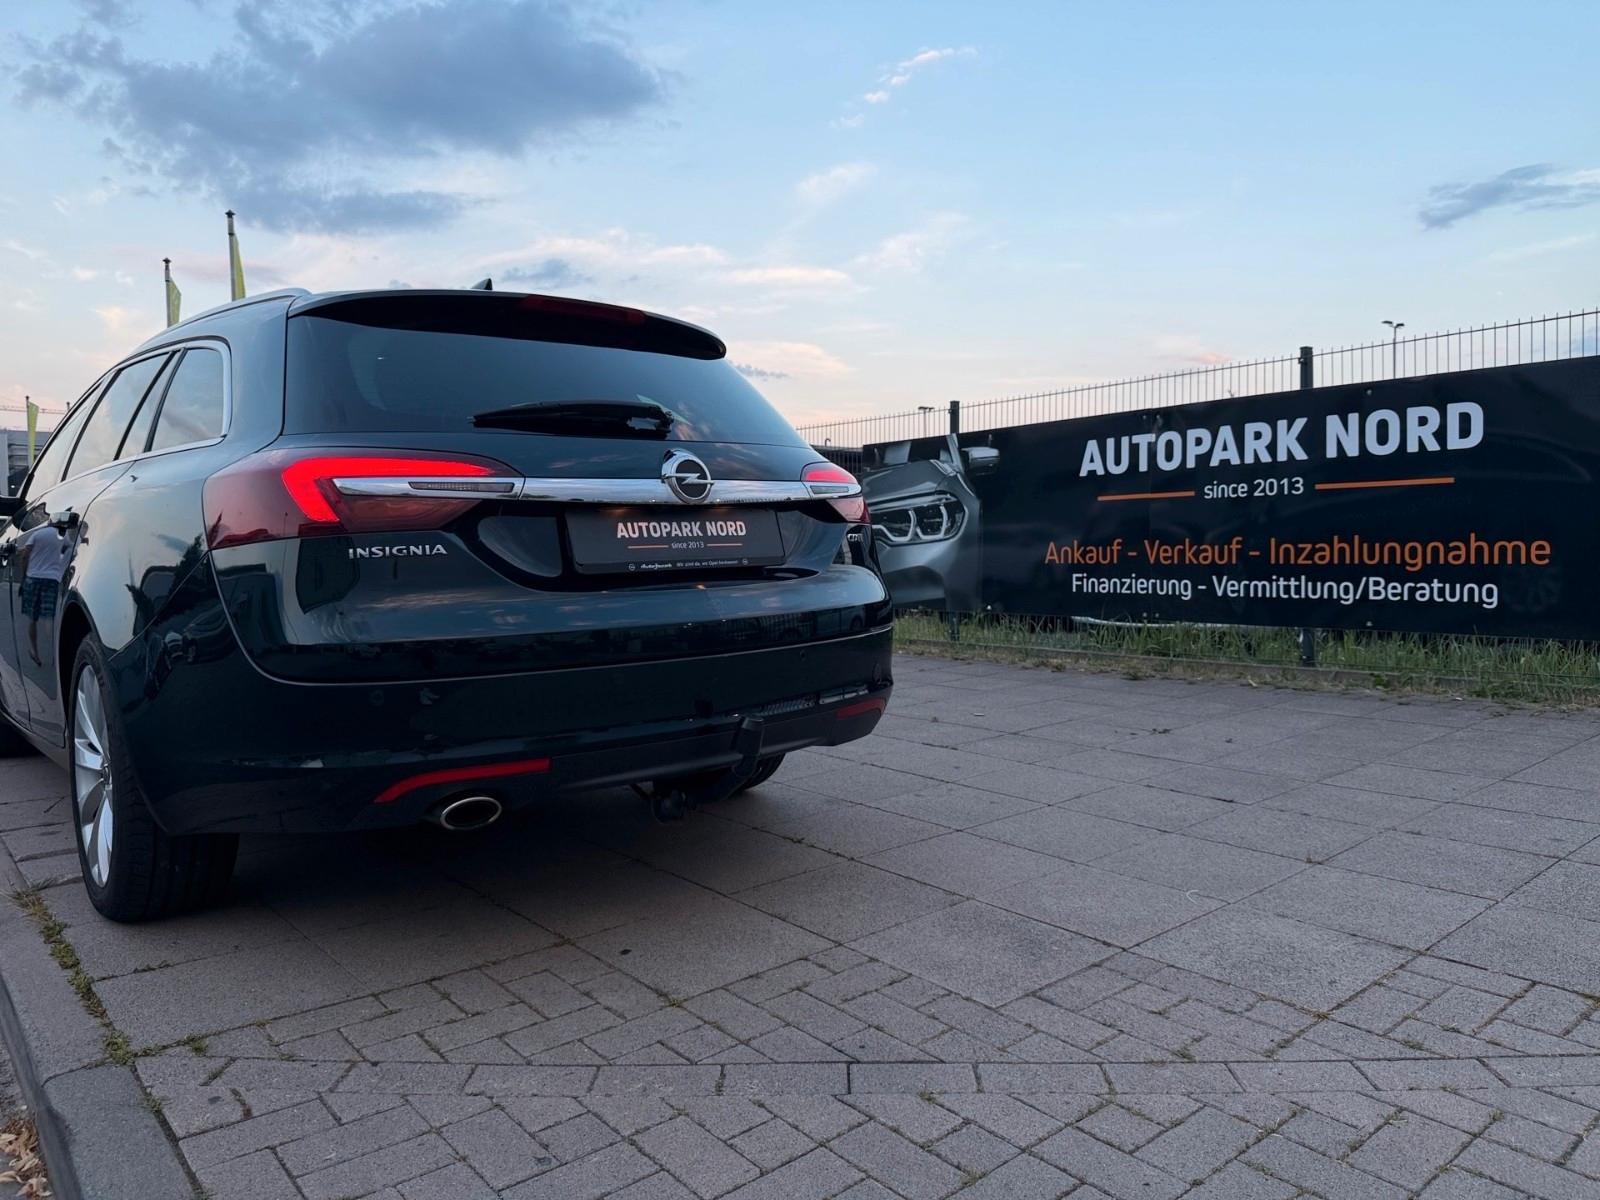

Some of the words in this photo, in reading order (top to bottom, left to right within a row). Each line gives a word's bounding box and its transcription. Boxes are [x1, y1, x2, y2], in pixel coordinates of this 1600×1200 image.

[1079, 417, 1309, 477] AUTOPARK
[1325, 401, 1484, 458] NORD
[1204, 480, 1247, 499] since
[1253, 476, 1304, 497] 2013
[617, 521, 703, 538] AUTOPARK
[706, 520, 747, 537] NORD
[348, 544, 448, 559] INSIGNIA
[688, 541, 704, 549] 2013
[1045, 538, 1122, 564] Ankauf
[1144, 537, 1242, 565] Verkauf
[1269, 533, 1551, 571] Inzahlungnahme
[1072, 573, 1192, 601] Finanzierung
[1212, 574, 1498, 609] Vermittlung/Beratung
